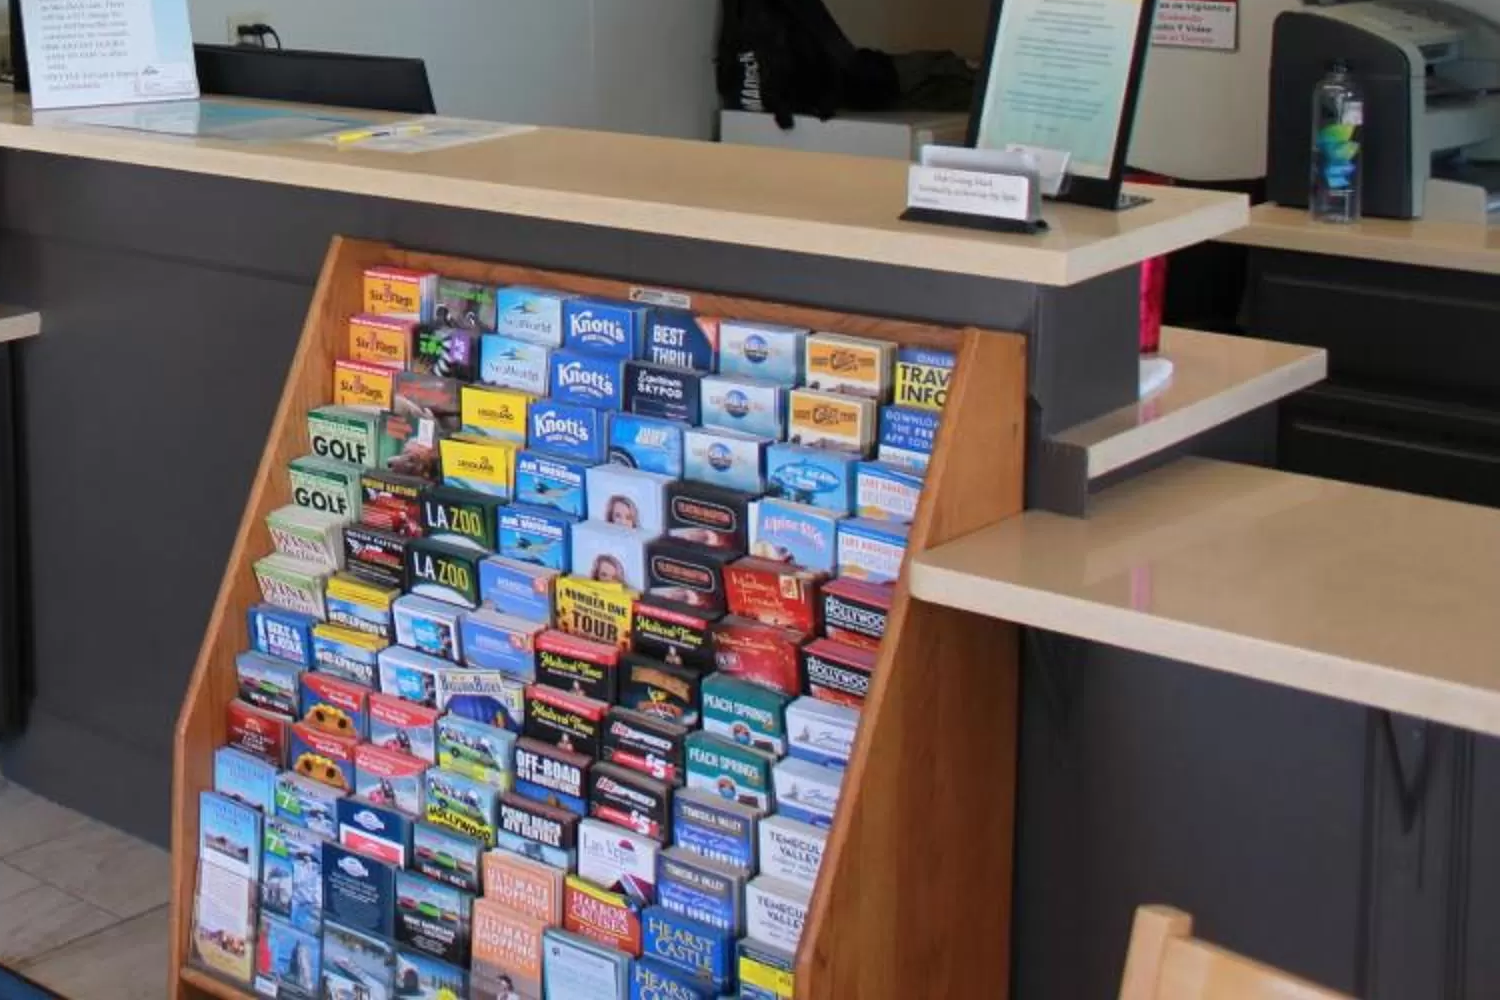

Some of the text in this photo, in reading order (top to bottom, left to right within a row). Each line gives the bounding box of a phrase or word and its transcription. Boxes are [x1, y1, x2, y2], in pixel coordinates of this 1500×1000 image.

[570, 311, 625, 343] Knott's
[653, 324, 687, 347] BEST
[558, 362, 613, 396] Knott's
[900, 366, 951, 386] TRAV
[534, 410, 589, 442] Knott's
[313, 435, 367, 464] GOLF
[295, 487, 347, 515] GOLF
[426, 502, 481, 536] LA ZOO
[413, 552, 469, 591] LA ZOO
[607, 601, 627, 617] ONE
[825, 598, 885, 630] HOLLYWOO
[572, 611, 619, 642] TOUR
[808, 657, 869, 691] HOLLYWOO
[516, 749, 581, 785] OFF-ROAD
[429, 805, 491, 840] HOLLYWOOD
[769, 831, 820, 855] TEMECUL
[757, 895, 803, 917] TEMECU
[768, 910, 804, 929] VALLE
[649, 917, 715, 954] HEARST
[655, 938, 714, 972] CASTLE
